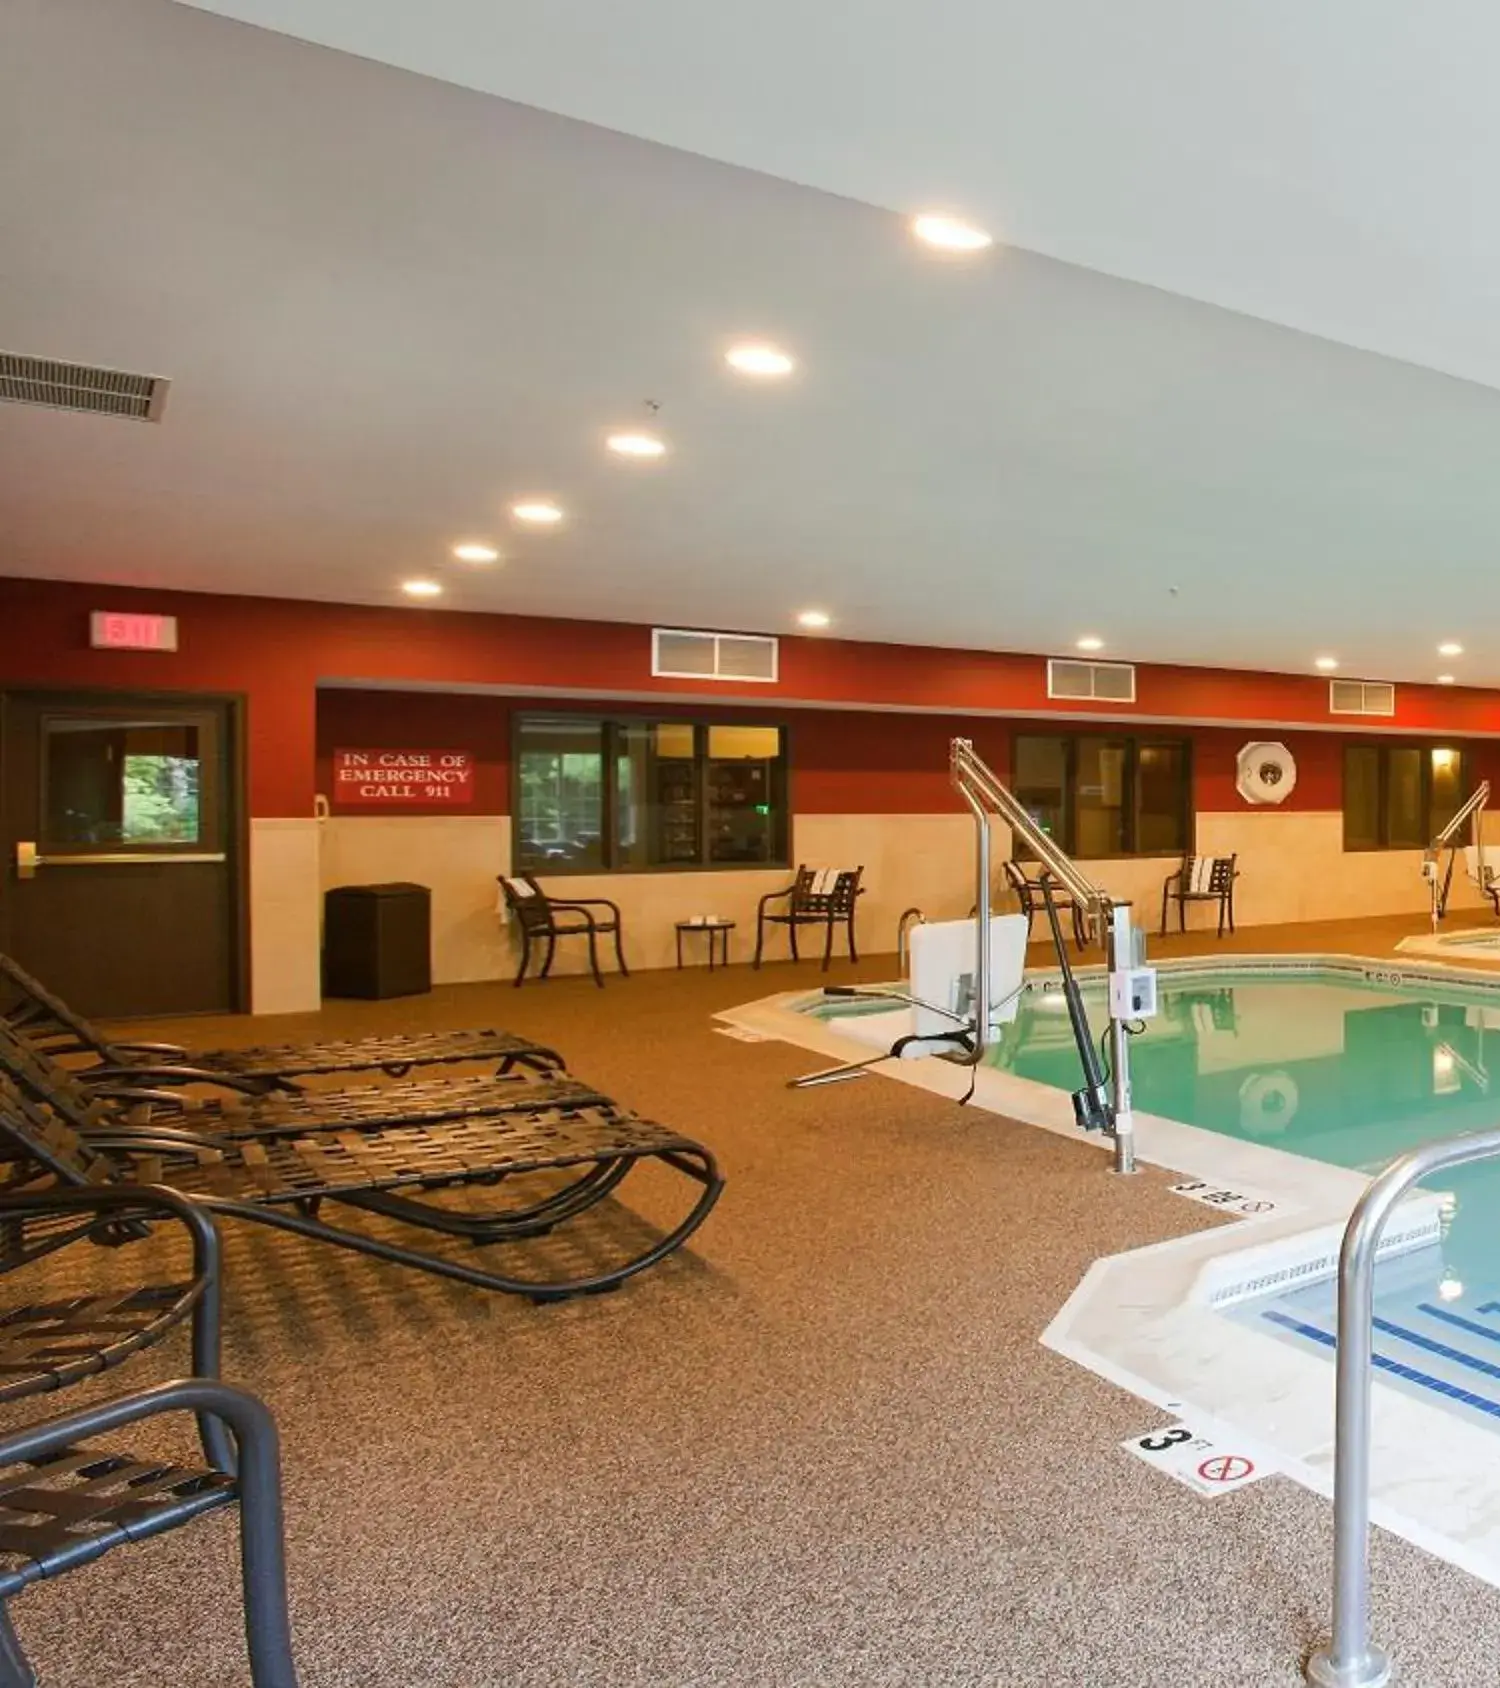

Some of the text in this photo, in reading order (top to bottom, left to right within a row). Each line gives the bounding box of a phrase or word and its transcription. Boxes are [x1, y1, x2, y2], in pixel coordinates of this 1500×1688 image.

[343, 752, 465, 767] IN CASE OF
[339, 768, 470, 783] EMERGENCY
[359, 784, 451, 798] CALL 911
[1139, 1429, 1192, 1450] 3
